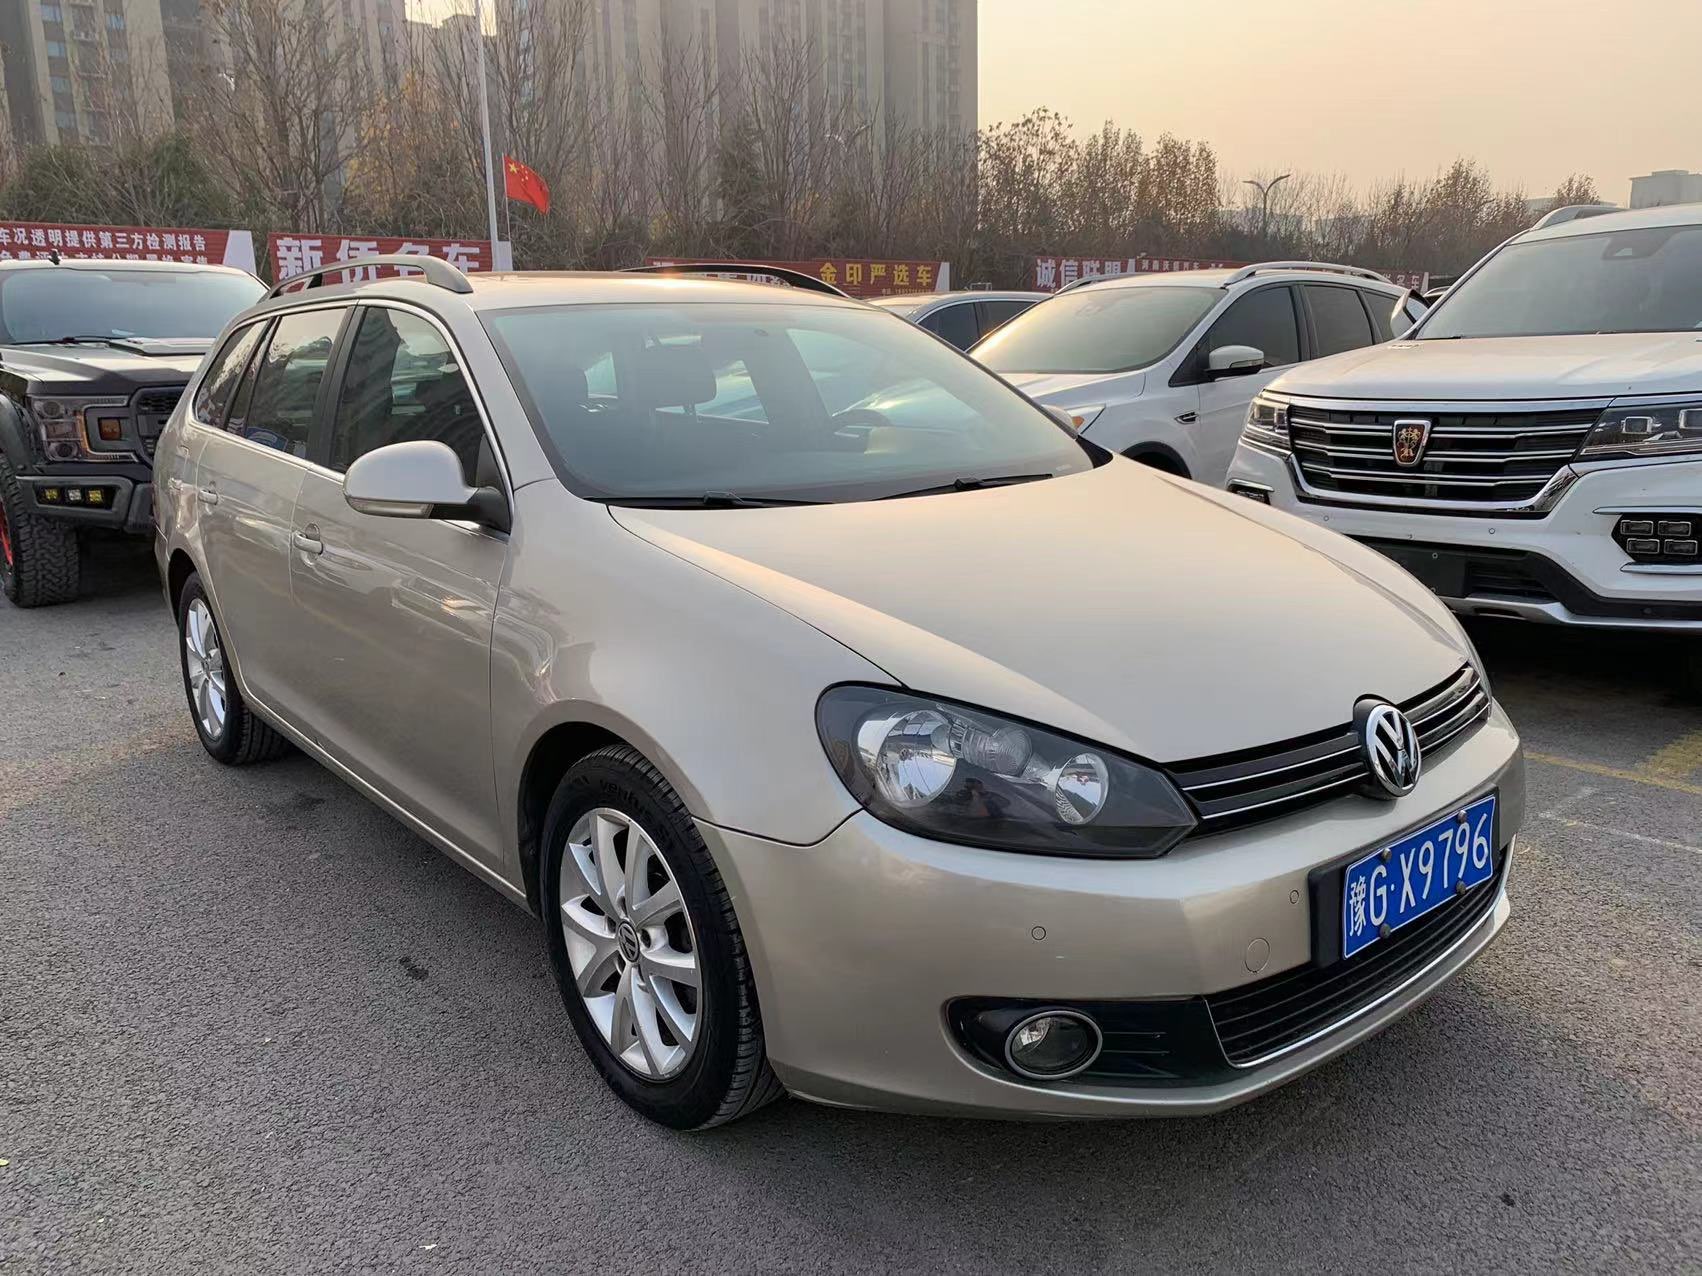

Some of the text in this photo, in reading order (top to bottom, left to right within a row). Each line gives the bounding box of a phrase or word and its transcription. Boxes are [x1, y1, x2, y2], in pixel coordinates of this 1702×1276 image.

[0, 227, 206, 251] 车况透明提供第三方检测报告
[819, 262, 932, 286] 金印严选车
